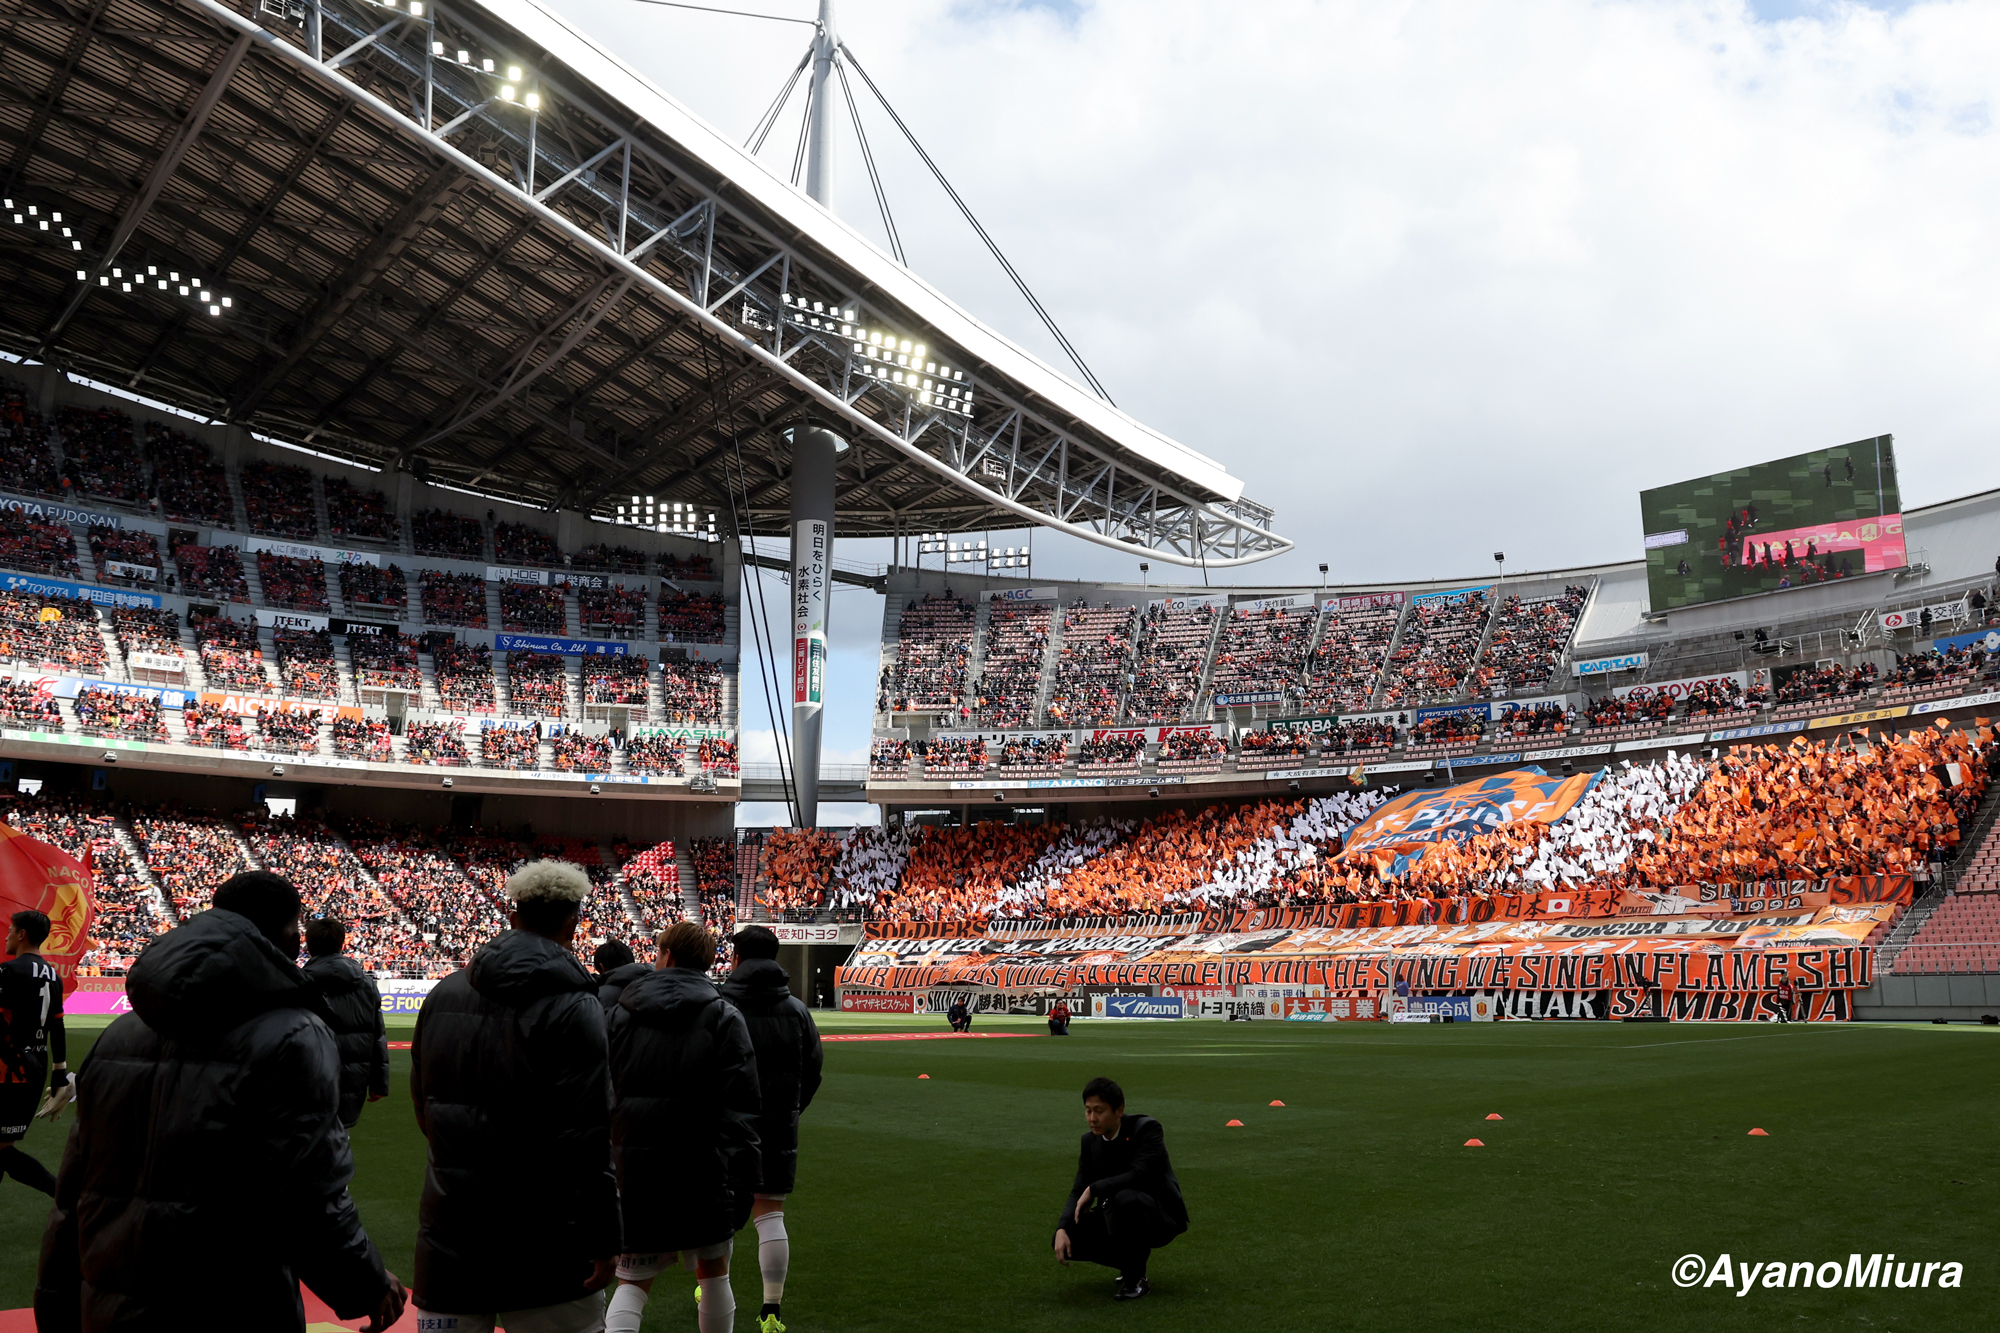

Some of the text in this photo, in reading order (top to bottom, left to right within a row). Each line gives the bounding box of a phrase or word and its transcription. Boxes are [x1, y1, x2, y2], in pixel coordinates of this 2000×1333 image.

[47, 507, 117, 529] FUDOSAN
[812, 524, 825, 601] 明日をひらく
[554, 573, 603, 588] 豊栄商会
[28, 583, 153, 608] TOYOTA 豊田自動織機
[797, 566, 809, 617] 水素社会
[1007, 589, 1032, 600] AGC
[1265, 597, 1295, 608] 矢作建設
[1906, 602, 1964, 624] 豊交通
[274, 615, 311, 628] JTEKT
[345, 624, 382, 636] JTEKT
[513, 639, 548, 650] Shinwa
[551, 642, 567, 652] Co.,
[568, 645, 587, 653] Ltd.
[812, 642, 820, 692] 三井住友銀行
[1657, 676, 1731, 698] TOYOTA
[220, 696, 281, 716] AICHI
[640, 728, 726, 739] HAYASHI
[1726, 722, 1800, 738] 碧海信用金庫
[1534, 745, 1609, 760] トヨタすまいるライフ
[1050, 778, 1105, 787] AMANO
[1120, 776, 1181, 785] トヨタホーム愛知
[1831, 875, 1908, 904] SMZ
[1505, 890, 1621, 918] 日本 清水
[984, 910, 1202, 940] SHIMIZU S-PULSE FOREVER
[1202, 904, 1344, 933] SMZ ULTRAS
[777, 928, 838, 940] 愛知トヨタ
[864, 920, 987, 939] SOLDIERS
[839, 965, 891, 988] OUR
[953, 963, 1000, 988] THIS
[1075, 963, 1198, 985] GATHERED
[1201, 961, 1251, 984] FOR
[1259, 960, 1312, 984] YOU
[1317, 958, 1374, 991] THE
[1465, 955, 1514, 990] WE
[1611, 951, 1648, 989] IN
[1652, 952, 1789, 992] FLAME
[1796, 945, 1871, 990] SHI
[854, 998, 910, 1011] ヤマザキビスケット
[1044, 998, 1084, 1013] JTKT
[1200, 1002, 1266, 1016] トヨタ紡織
[1410, 1001, 1470, 1017] 豊田合成
[1610, 990, 1850, 1022] SAMBISTA
